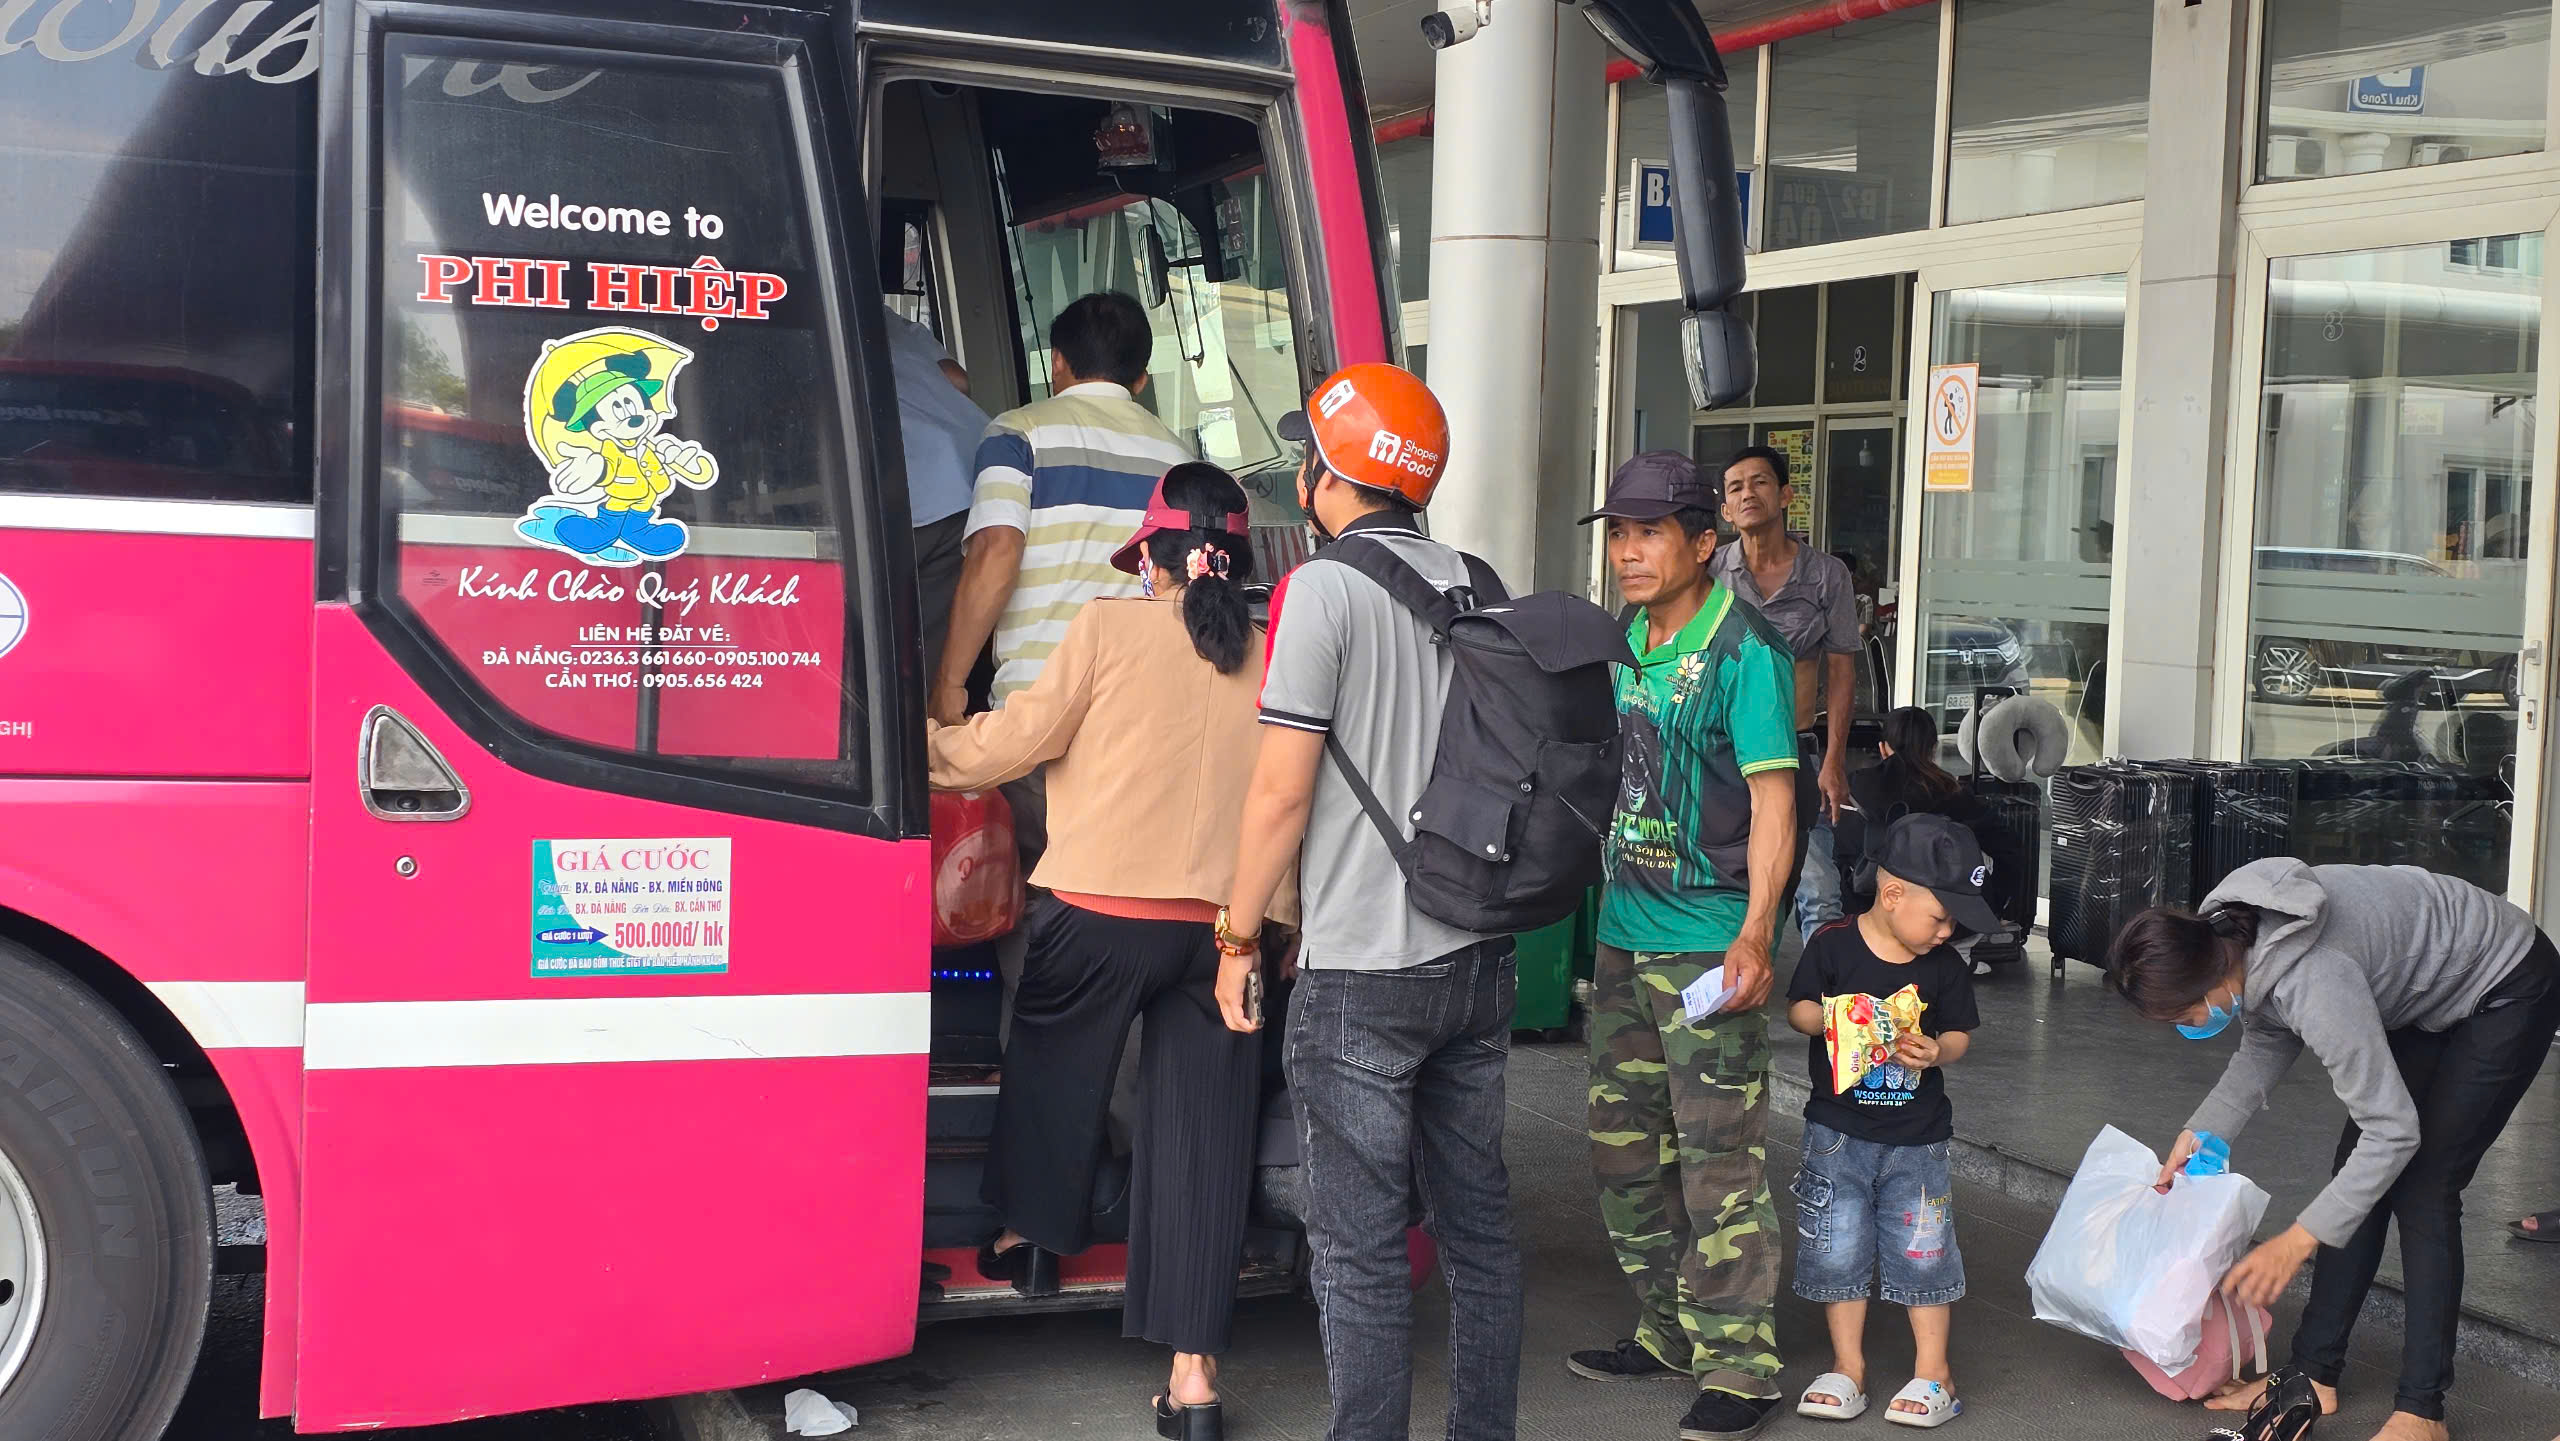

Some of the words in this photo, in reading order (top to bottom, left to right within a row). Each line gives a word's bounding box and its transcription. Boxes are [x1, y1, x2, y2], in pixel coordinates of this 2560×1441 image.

[482, 192, 671, 236] Welcome
[683, 206, 724, 240] to
[416, 254, 570, 309] PHI
[587, 255, 788, 332] HIỆP
[2322, 310, 2344, 342] 3
[1854, 345, 1867, 372] 2
[1404, 440, 1438, 462] Shopee
[1396, 453, 1436, 478] Food
[458, 565, 539, 601] Kính
[547, 569, 624, 602] Chào
[635, 571, 700, 617] Quý
[709, 572, 799, 607] Khách
[579, 624, 620, 642] LIÊN
[626, 623, 652, 645] HỆ
[699, 623, 731, 642] VÉ:
[482, 646, 510, 665] ĐÀ
[545, 667, 587, 687] CẦN
[592, 672, 638, 688] THƠ:
[643, 673, 727, 688] 0905.656
[731, 673, 763, 688] 424
[556, 844, 612, 872] GIÁ
[621, 843, 710, 871] CƯỚC
[575, 881, 592, 894] BX.
[594, 880, 609, 894] ĐÀ
[648, 881, 665, 893] BX.
[703, 921, 723, 946] hk
